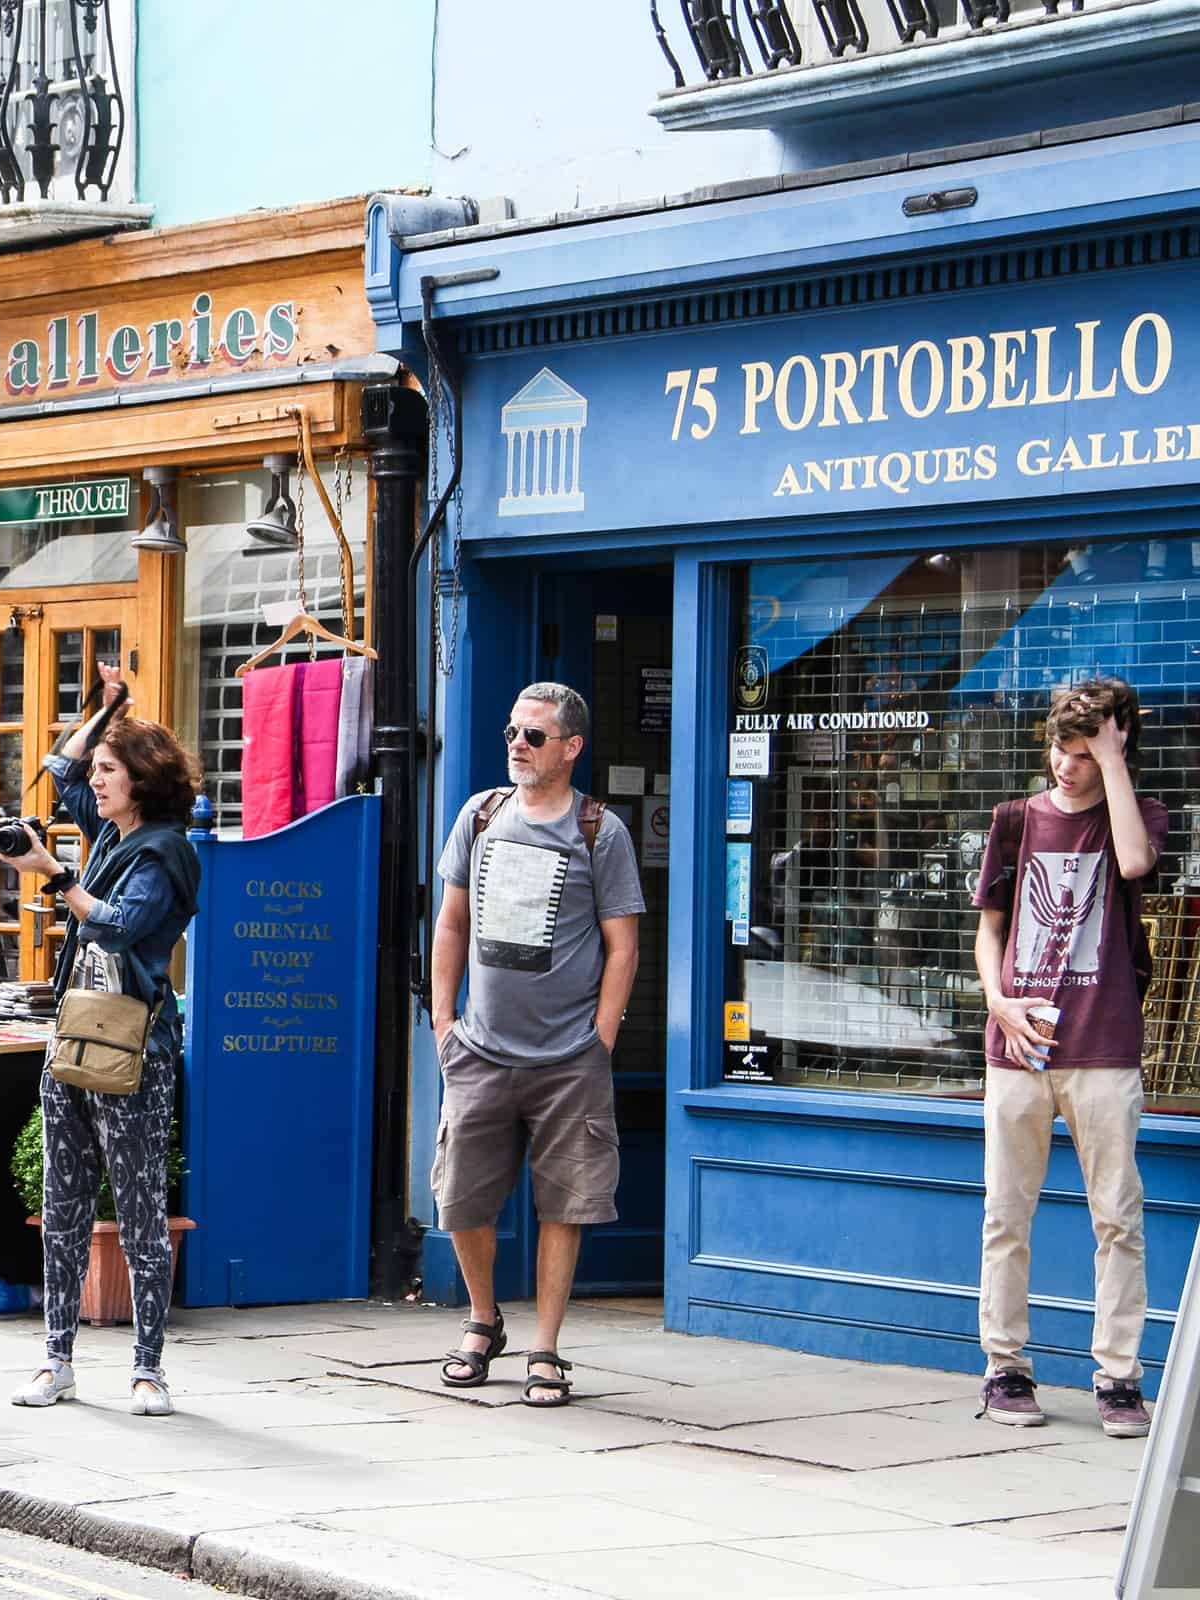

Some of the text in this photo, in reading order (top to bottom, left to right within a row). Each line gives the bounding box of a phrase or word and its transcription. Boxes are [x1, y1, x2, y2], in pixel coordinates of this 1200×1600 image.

[664, 311, 1173, 442] 75 PORTOBELLO
[773, 444, 998, 498] ANTIQUES
[35, 482, 128, 516] THROUGH
[735, 711, 930, 731] FULLY AIR CONDITIONED
[737, 749, 753, 757] MUST
[246, 880, 322, 898] CLOCKS
[233, 921, 336, 941] ORIENTAL
[251, 950, 314, 968] IVORY
[224, 991, 339, 1010] CHESS SETS
[223, 1034, 337, 1053] SCULPTURE
